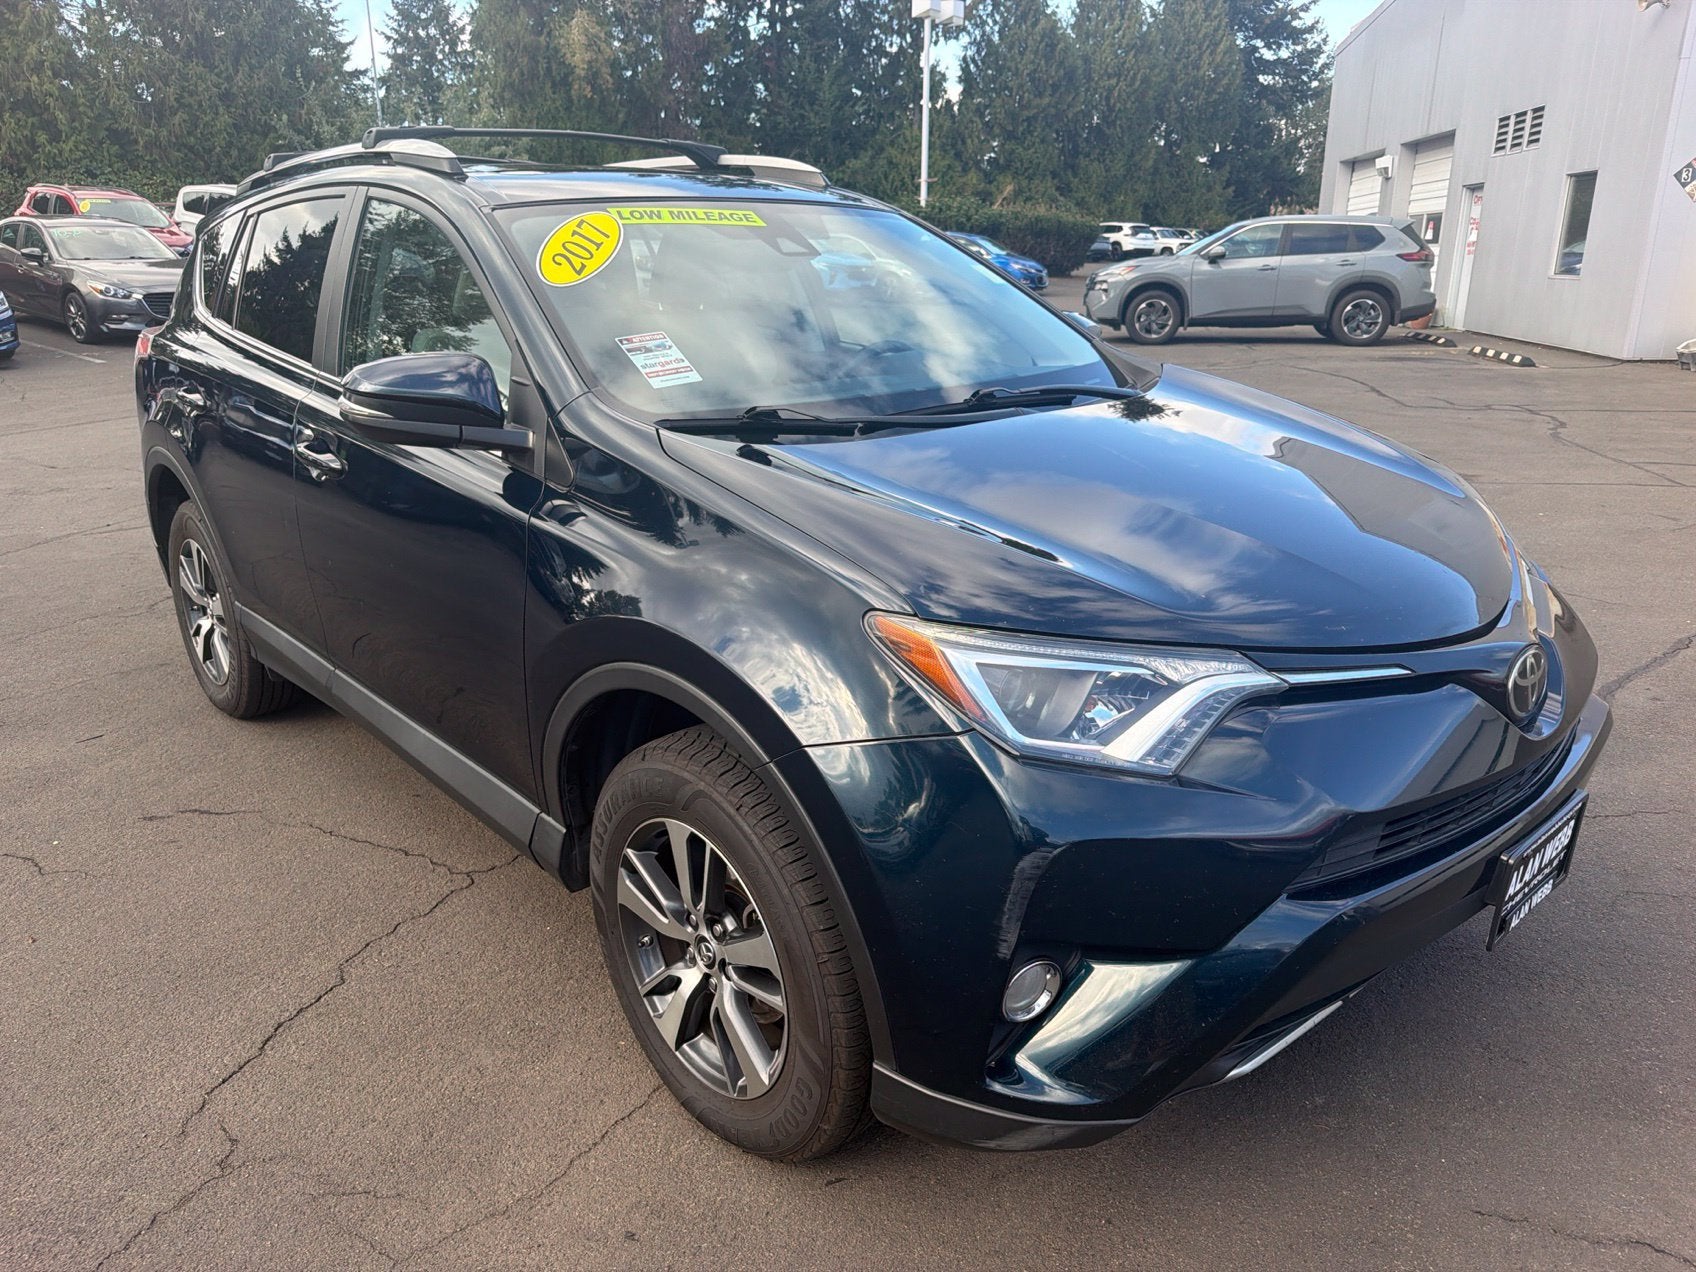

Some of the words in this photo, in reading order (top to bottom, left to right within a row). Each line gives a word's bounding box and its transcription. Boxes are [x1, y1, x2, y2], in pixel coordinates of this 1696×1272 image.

[1682, 168, 1691, 182] 3
[616, 209, 662, 221] LOW
[668, 210, 758, 223] MILEAGE
[551, 218, 611, 276] 2017
[1504, 847, 1544, 902] ALAN
[1541, 818, 1576, 869] WEBB
[1508, 898, 1531, 932] ALAN
